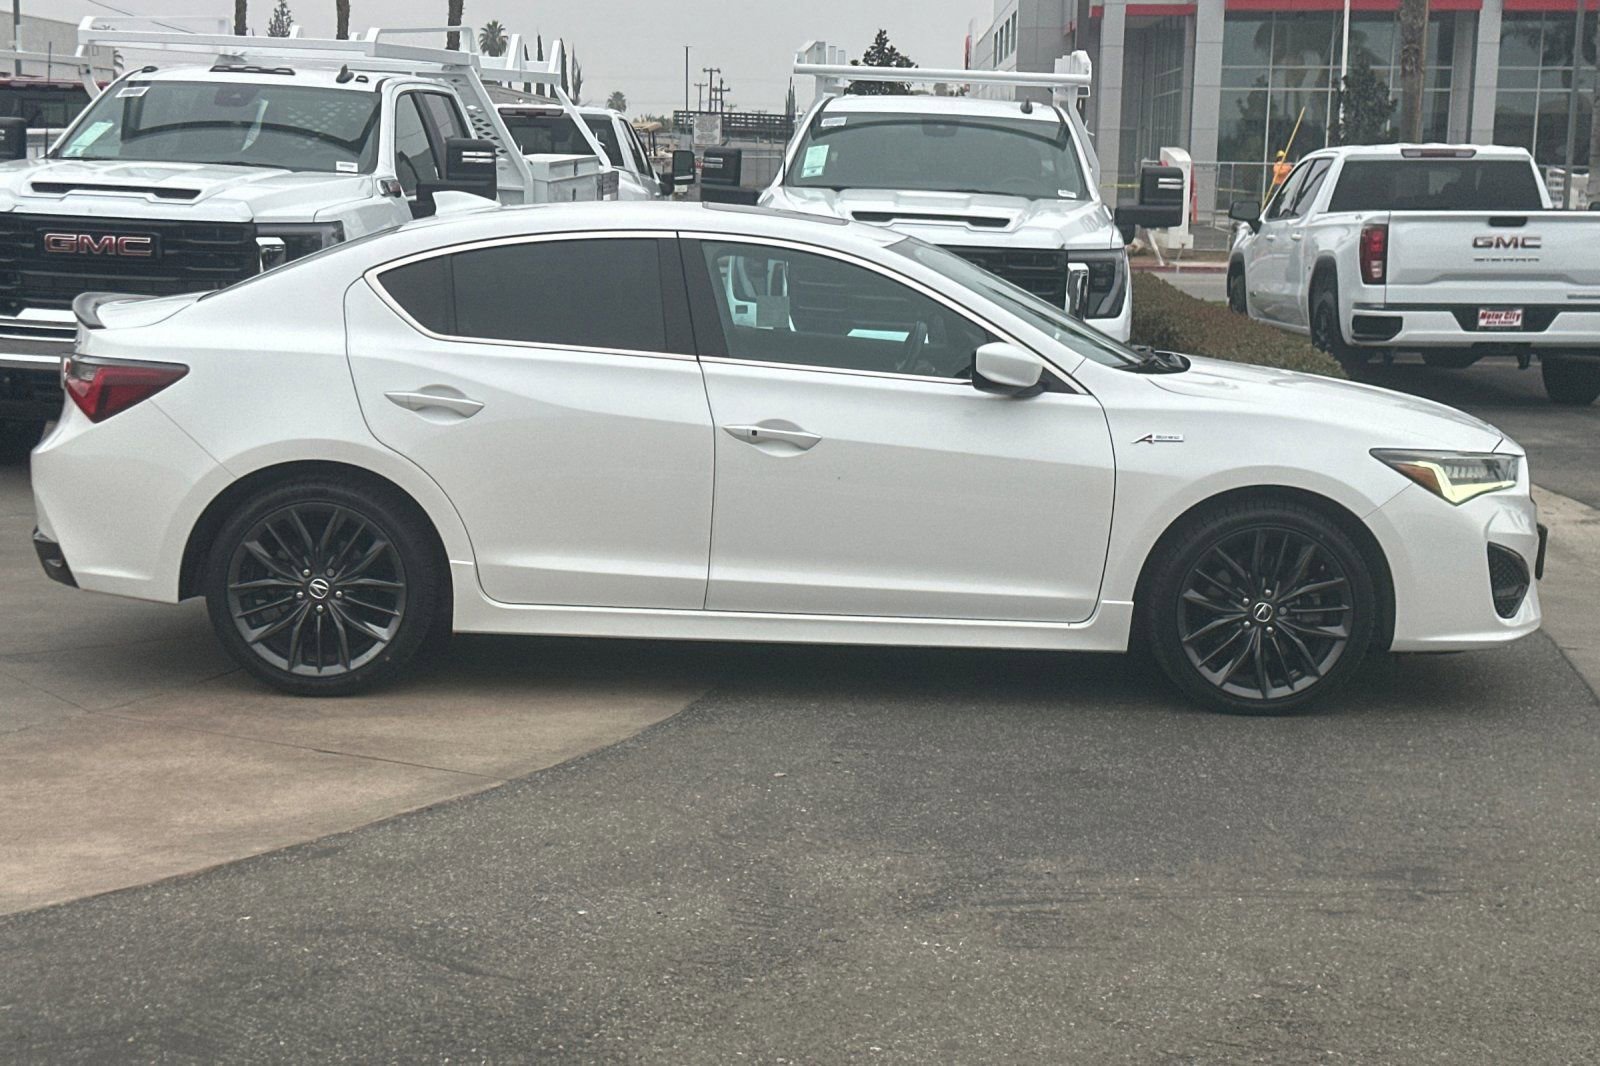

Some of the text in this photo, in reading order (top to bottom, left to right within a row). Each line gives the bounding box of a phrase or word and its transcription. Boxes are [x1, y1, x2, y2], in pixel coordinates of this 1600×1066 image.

[44, 233, 152, 257] GMC
[1472, 236, 1542, 249] GMC
[1480, 311, 1521, 322] Motor City
